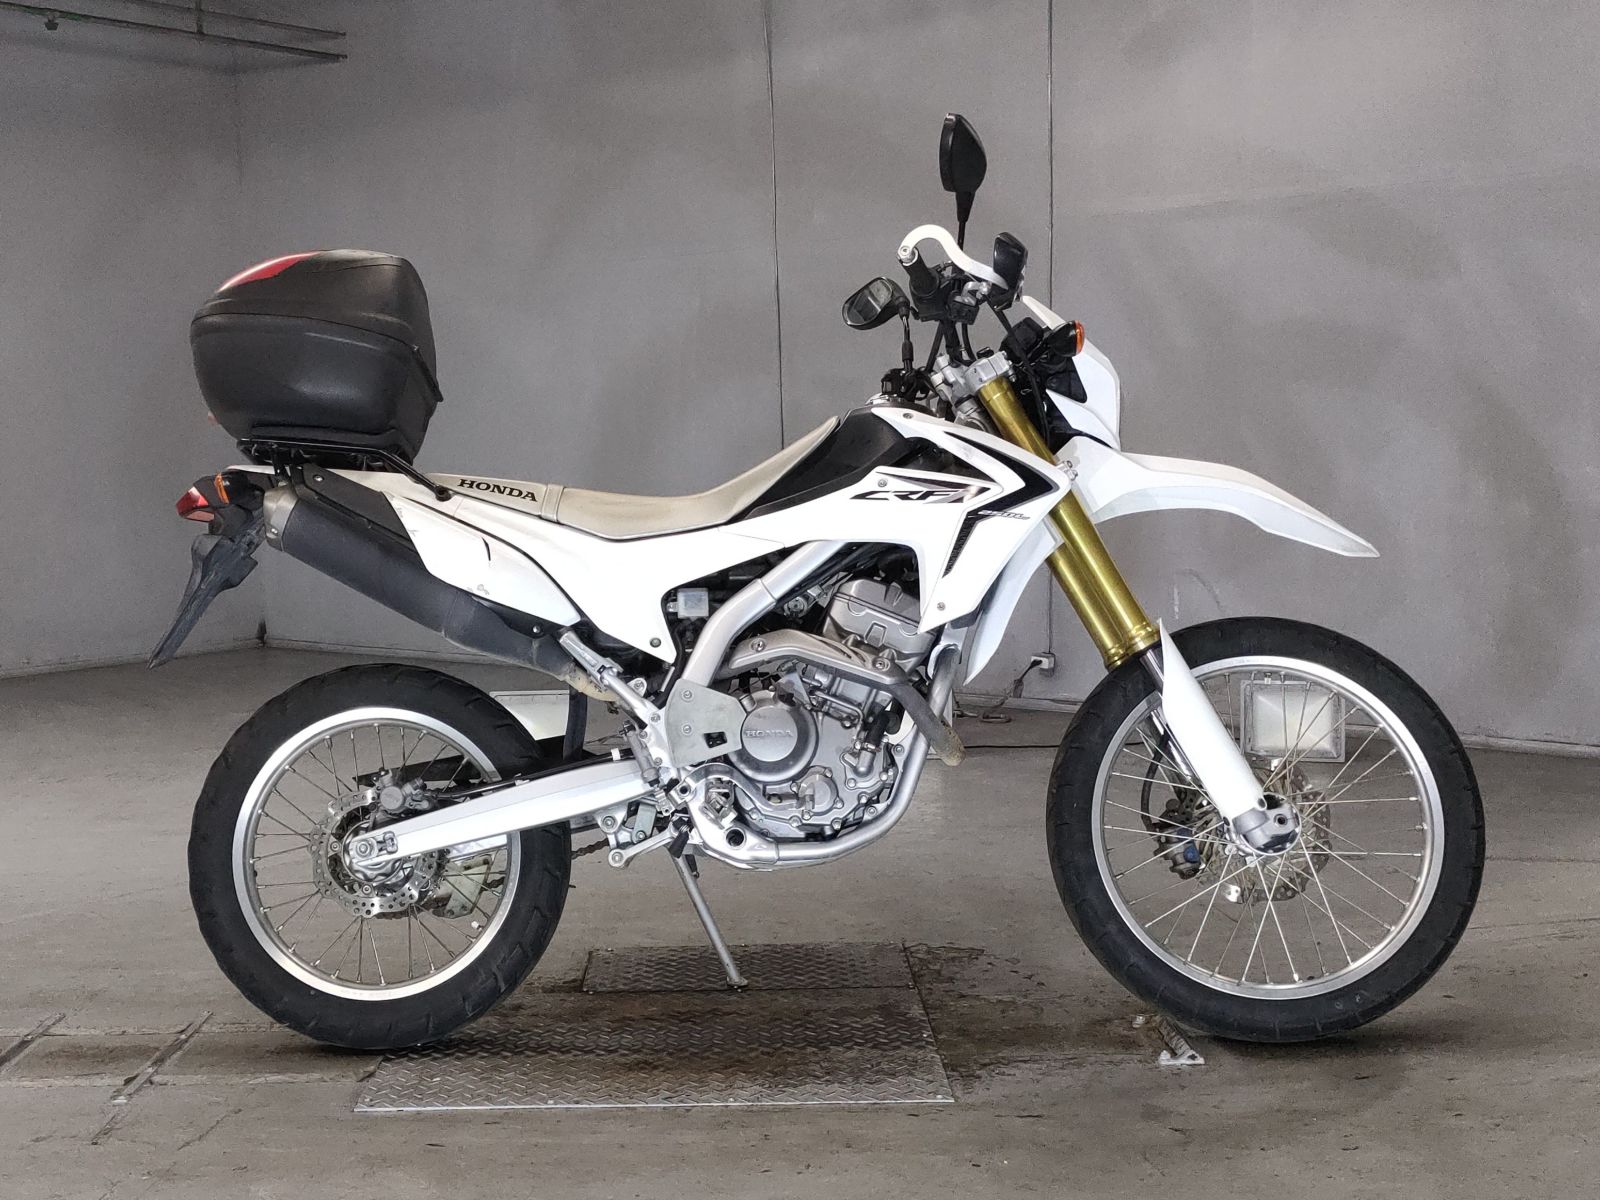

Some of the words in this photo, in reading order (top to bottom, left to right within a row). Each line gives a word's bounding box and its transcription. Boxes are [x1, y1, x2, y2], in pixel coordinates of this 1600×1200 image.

[458, 479, 538, 502] HONDA
[849, 490, 961, 501] CRF
[744, 730, 793, 738] HONDA
